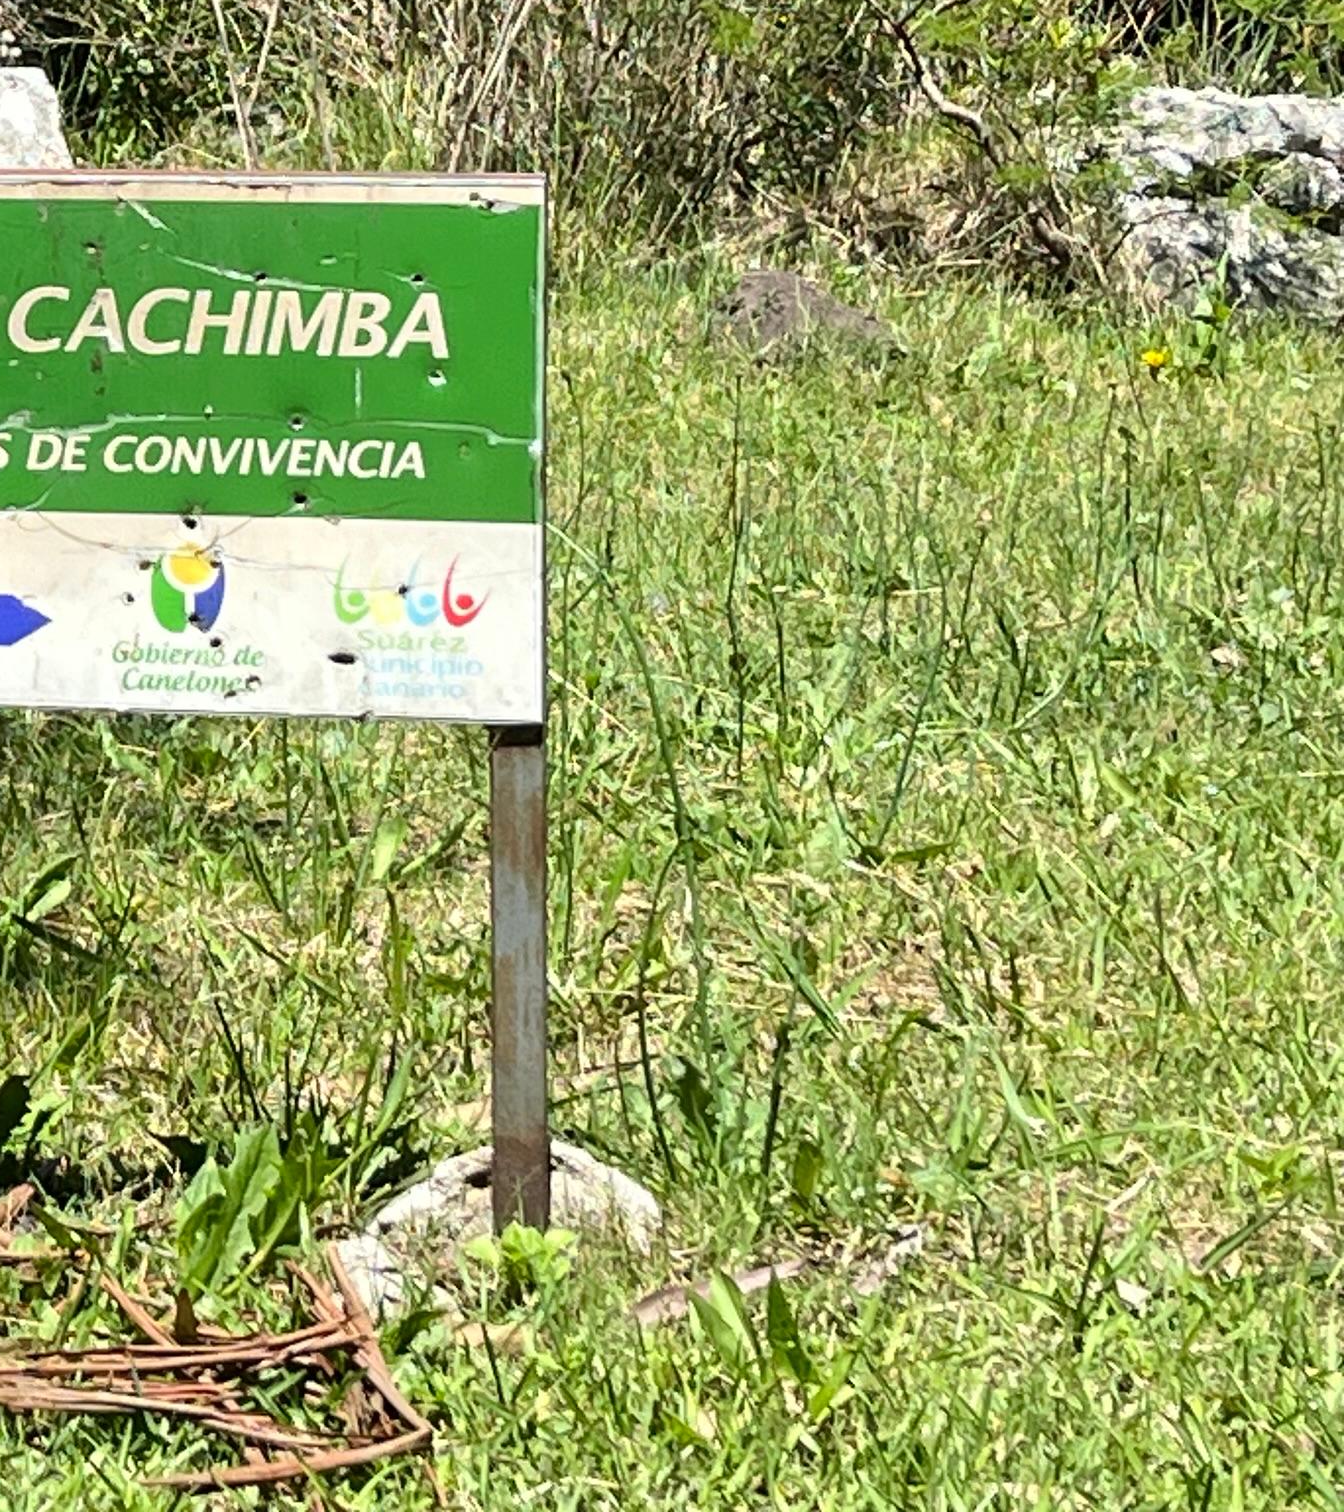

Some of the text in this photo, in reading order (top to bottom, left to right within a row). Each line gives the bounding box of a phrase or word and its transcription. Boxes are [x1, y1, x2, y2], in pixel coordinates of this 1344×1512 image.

[7, 285, 450, 359] CACHIMBA
[25, 432, 89, 472] DE
[103, 435, 427, 479] CONVIVENCIA
[112, 639, 265, 668] Gobierno de
